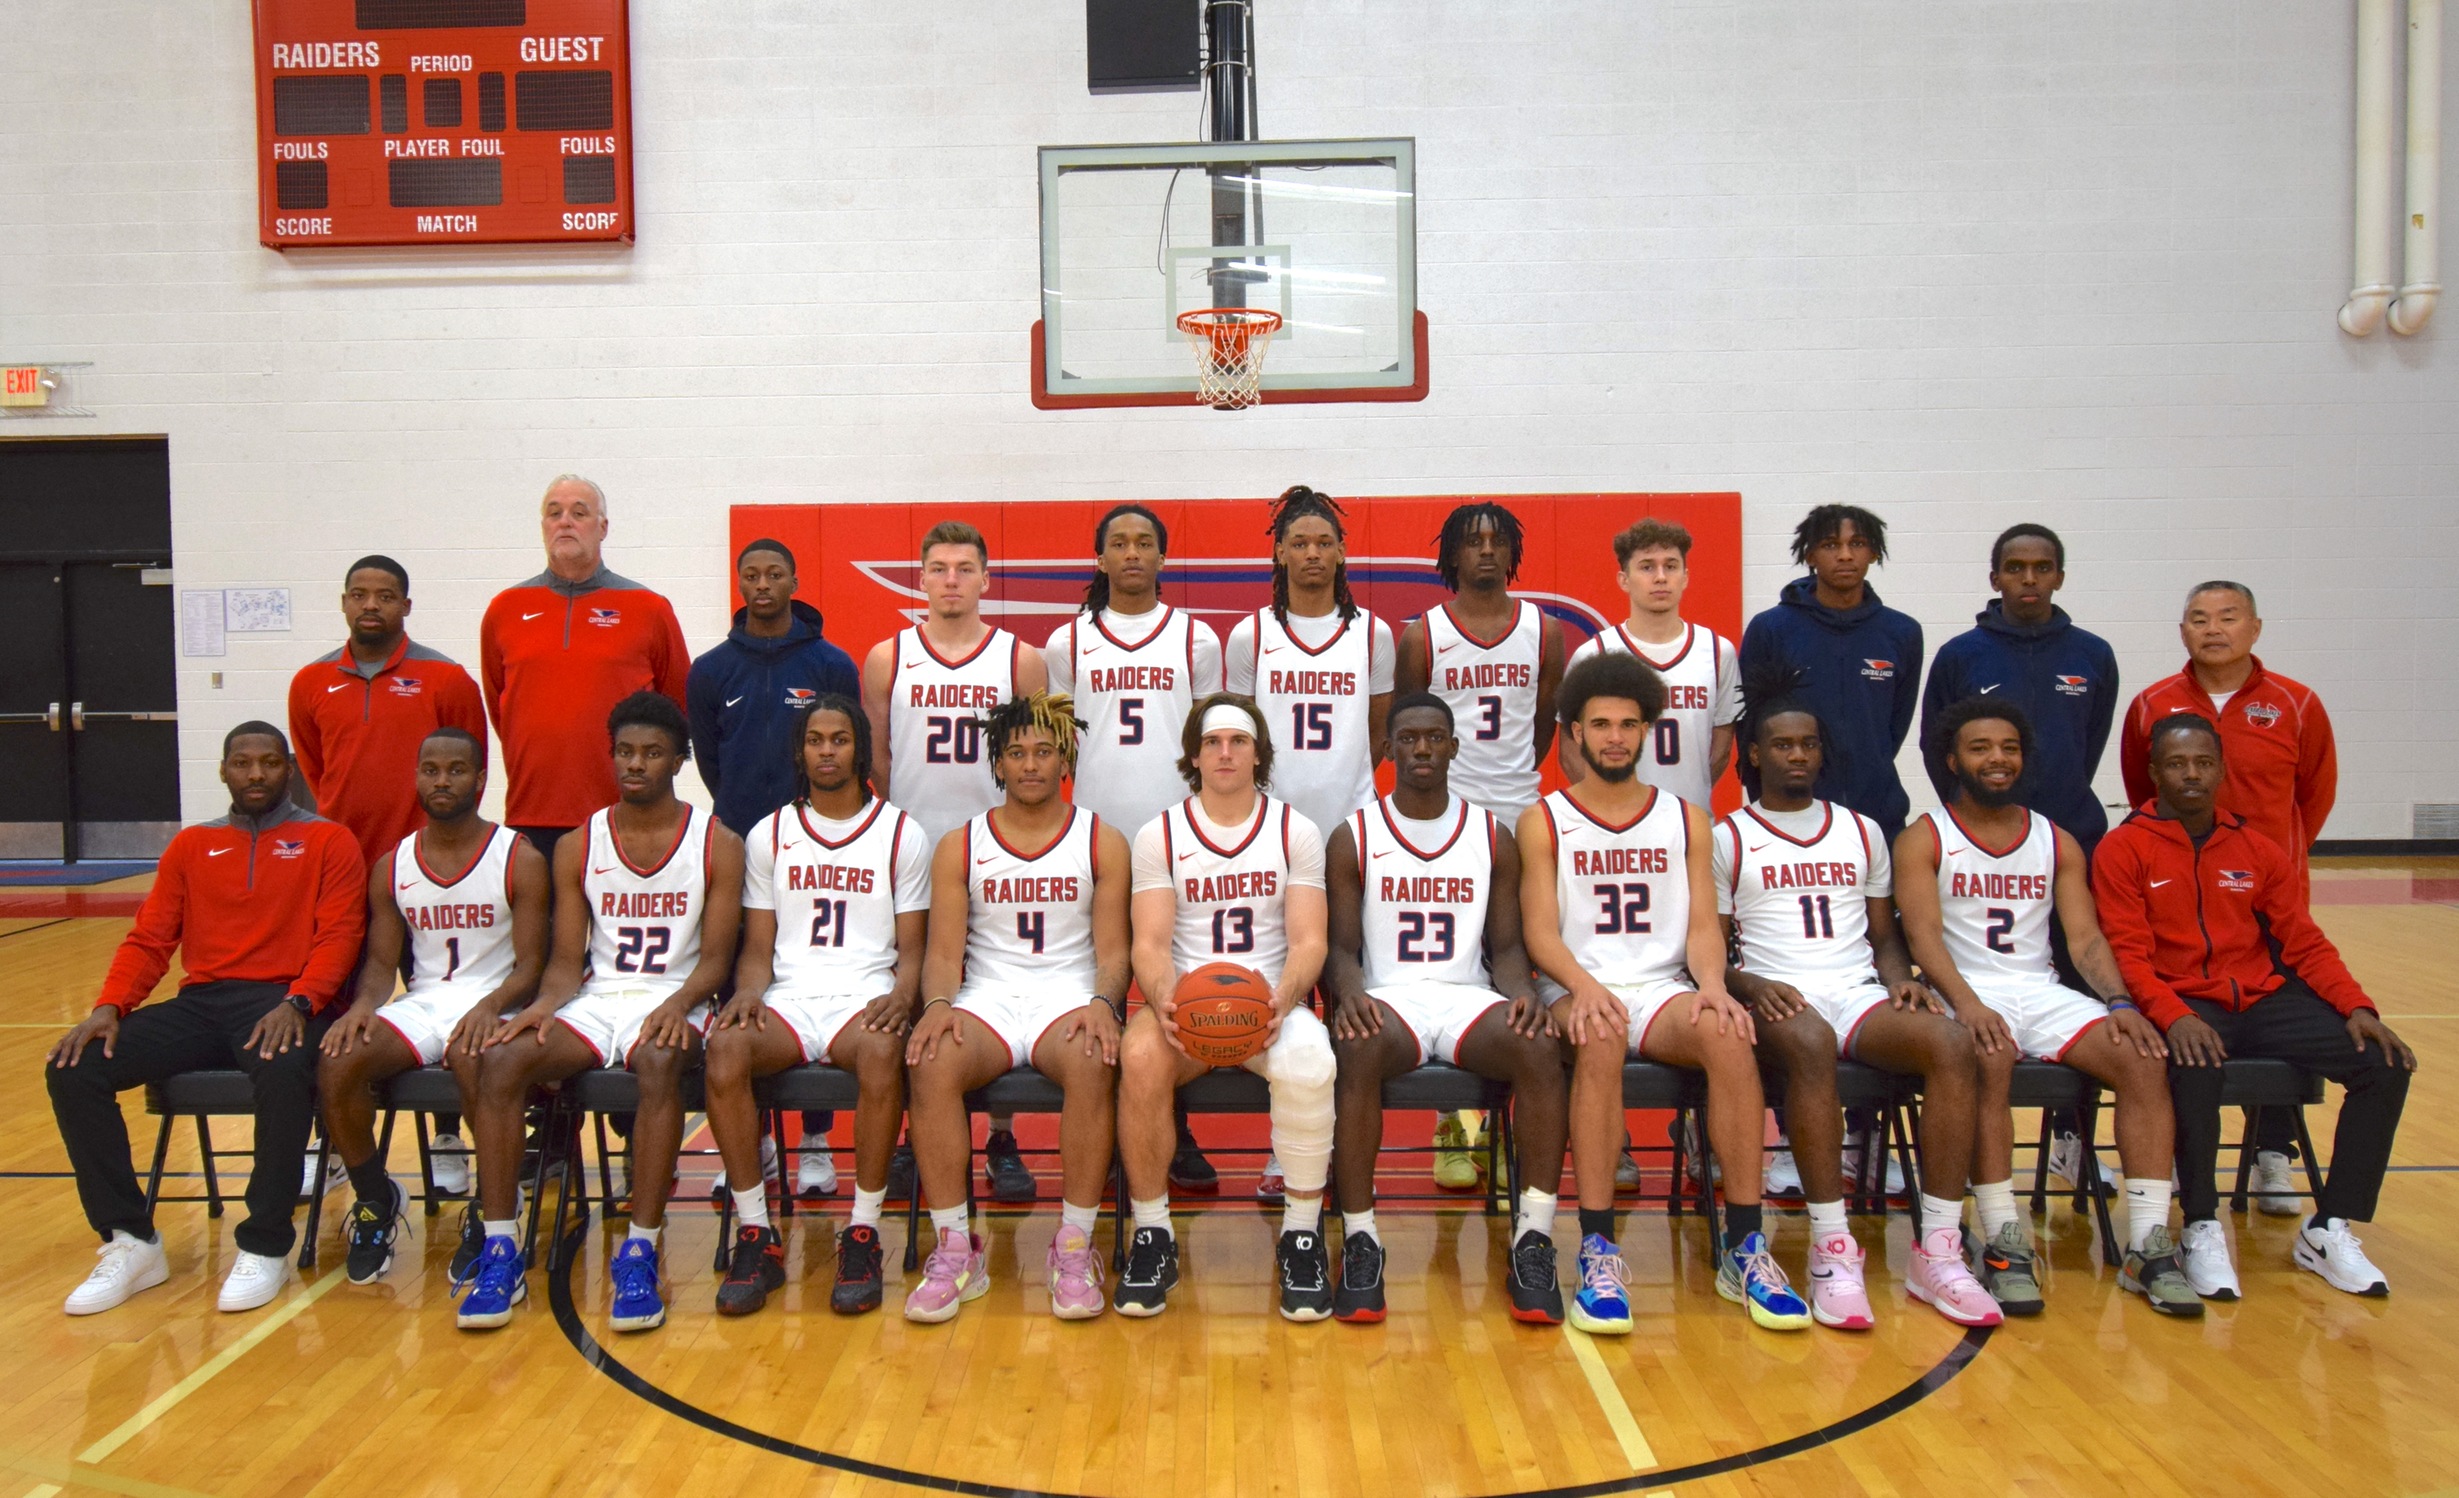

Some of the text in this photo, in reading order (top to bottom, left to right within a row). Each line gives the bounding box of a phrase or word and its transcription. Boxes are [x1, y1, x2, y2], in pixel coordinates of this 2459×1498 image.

[273, 41, 380, 69] RAIDERS
[411, 54, 473, 72] PERIOD
[520, 36, 604, 63] GUEST
[273, 142, 328, 160] FOULS
[384, 138, 505, 158] PLAYER FOUL
[560, 136, 615, 155] FOULS
[275, 217, 332, 236] SCORE
[417, 214, 477, 233] MATCH
[6, 369, 37, 394] EXIT
[1091, 666, 1174, 693] RAIDERS
[1269, 670, 1356, 696] RAIDERS
[1446, 664, 1530, 691] RAIDERS
[911, 684, 998, 709] RAIDERS
[1119, 698, 1145, 745] 5
[1292, 702, 1333, 751] 15
[1475, 695, 1503, 743] 3
[926, 715, 979, 764] 20
[1655, 717, 1680, 766] 0
[1573, 847, 1669, 876] RAIDERS
[1761, 861, 1858, 890] RAIDERS
[788, 864, 875, 894] RAIDERS
[982, 876, 1079, 904] RAIDERS
[1184, 870, 1278, 903] RAIDERS
[1380, 876, 1474, 904] RAIDERS
[1952, 872, 2047, 900] RAIDERS
[405, 903, 494, 931] RAIDERS
[601, 891, 689, 918] RAIDERS
[1593, 882, 1652, 934] 32
[1797, 894, 1835, 940] 11
[809, 897, 847, 948] 21
[1016, 911, 1045, 955] 4
[1211, 906, 1255, 954] 13
[1985, 907, 2016, 955] 2
[615, 926, 671, 975] 22
[1397, 911, 1456, 963] 23
[440, 937, 460, 982] 1
[1189, 1010, 1258, 1028] SPALDING
